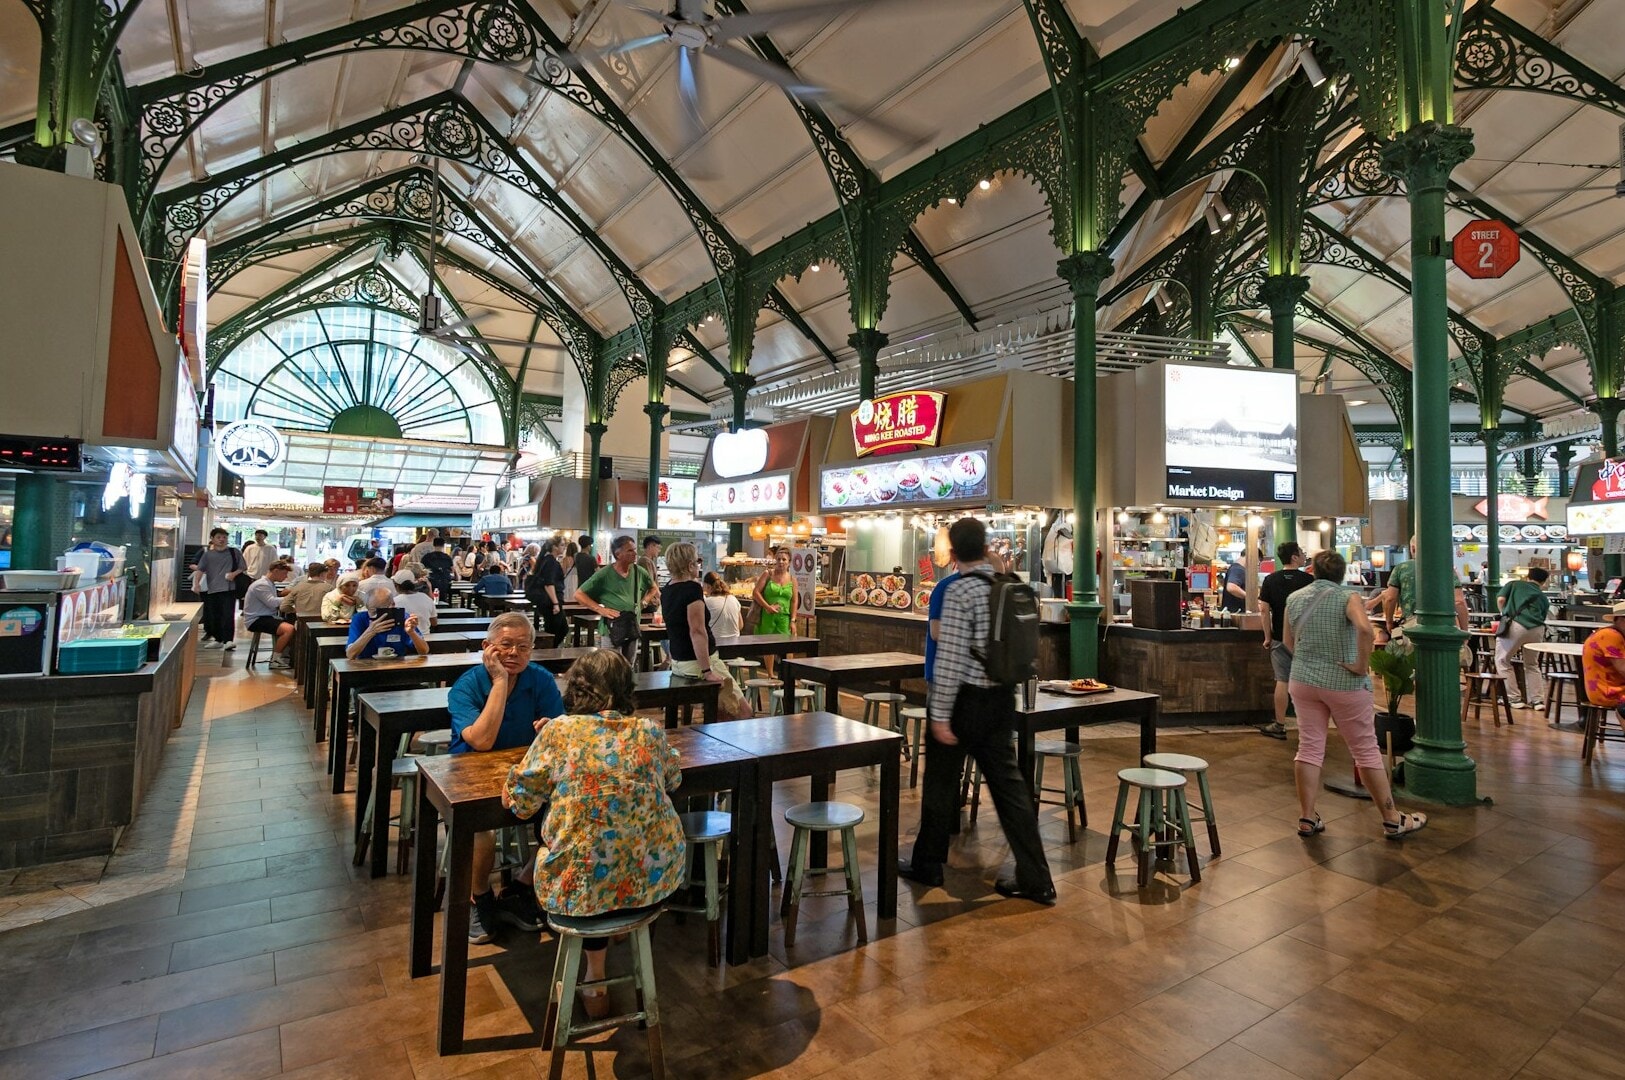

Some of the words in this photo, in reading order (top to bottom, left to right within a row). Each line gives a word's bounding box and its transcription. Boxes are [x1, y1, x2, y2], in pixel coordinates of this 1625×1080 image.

[1471, 230, 1499, 240] STREET
[1478, 242, 1494, 268] 2
[881, 431, 894, 441] KEE
[894, 425, 926, 438] ROASTED
[1168, 484, 1208, 497] Market
[1208, 486, 1245, 500] Design
